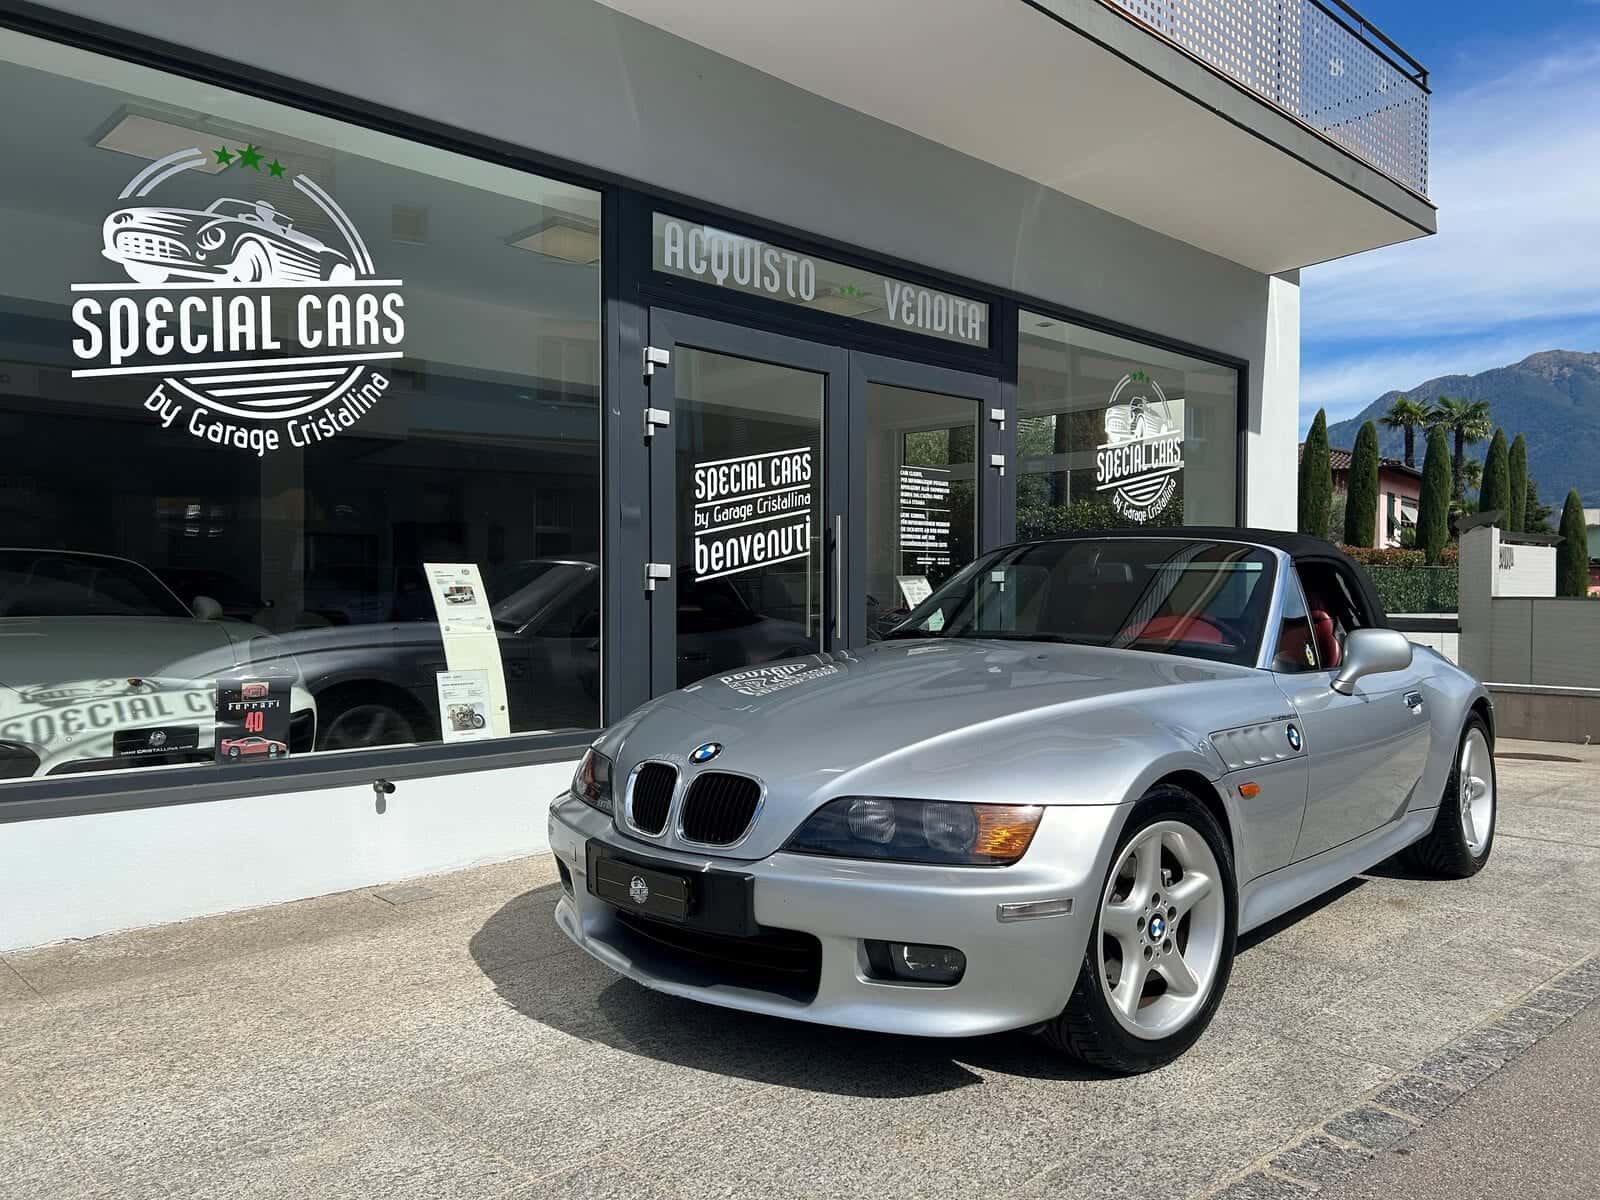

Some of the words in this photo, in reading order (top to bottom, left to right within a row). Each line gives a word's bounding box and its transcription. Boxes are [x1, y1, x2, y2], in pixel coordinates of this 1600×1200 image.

[663, 221, 816, 302] ACQUISTO
[884, 278, 982, 342] VENDITA
[71, 294, 281, 365] SPECIAL
[298, 293, 405, 349] CARS
[143, 383, 182, 428] by
[188, 408, 279, 457] Garage
[286, 371, 390, 448] Cristallina
[695, 460, 766, 501] SPECIAL
[771, 453, 811, 486] CARS
[1096, 442, 1147, 483] SPECIAL
[1151, 437, 1181, 469] CARS
[695, 509, 709, 529] by
[714, 504, 753, 521] Garage
[757, 491, 811, 514] Cristallina
[1113, 490, 1122, 513] by
[1123, 502, 1147, 525] Garage
[1147, 478, 1177, 519] Cristallina
[695, 514, 811, 575] benvenuti
[228, 699, 281, 711] Ferrari
[245, 711, 264, 733] 40
